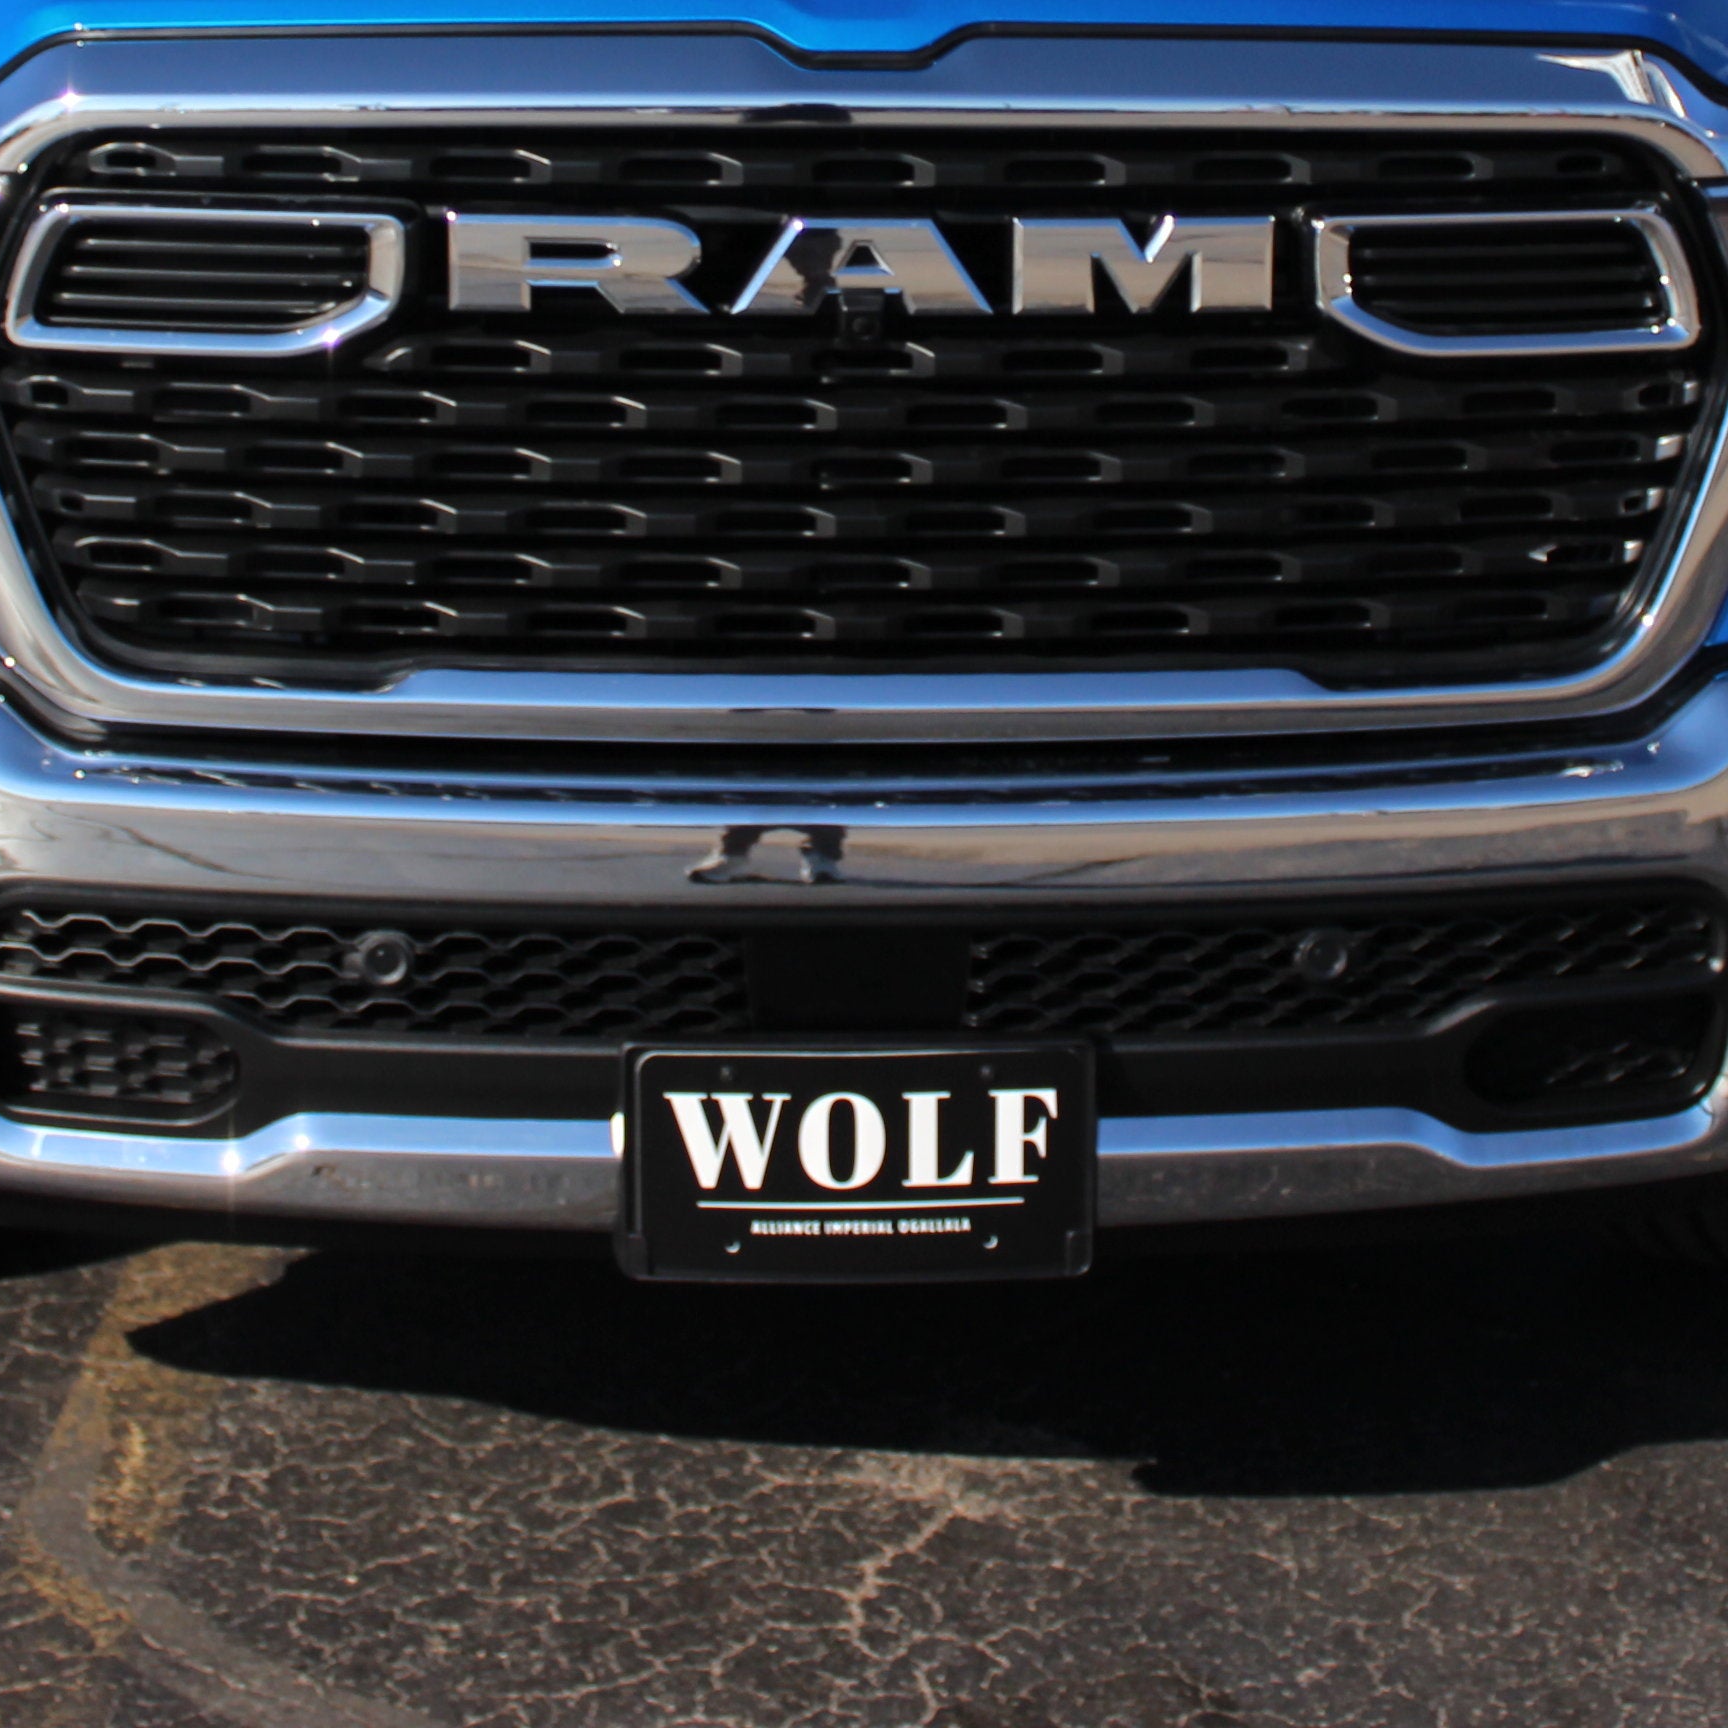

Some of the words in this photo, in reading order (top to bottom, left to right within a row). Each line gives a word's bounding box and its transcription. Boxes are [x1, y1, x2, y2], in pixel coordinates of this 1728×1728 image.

[447, 212, 1276, 315] RAM
[662, 1087, 1059, 1190] WOLF
[750, 1219, 821, 1235] ALLIANCE
[823, 1219, 894, 1235] IMPERIAL
[897, 1216, 972, 1234] OGALLALA
